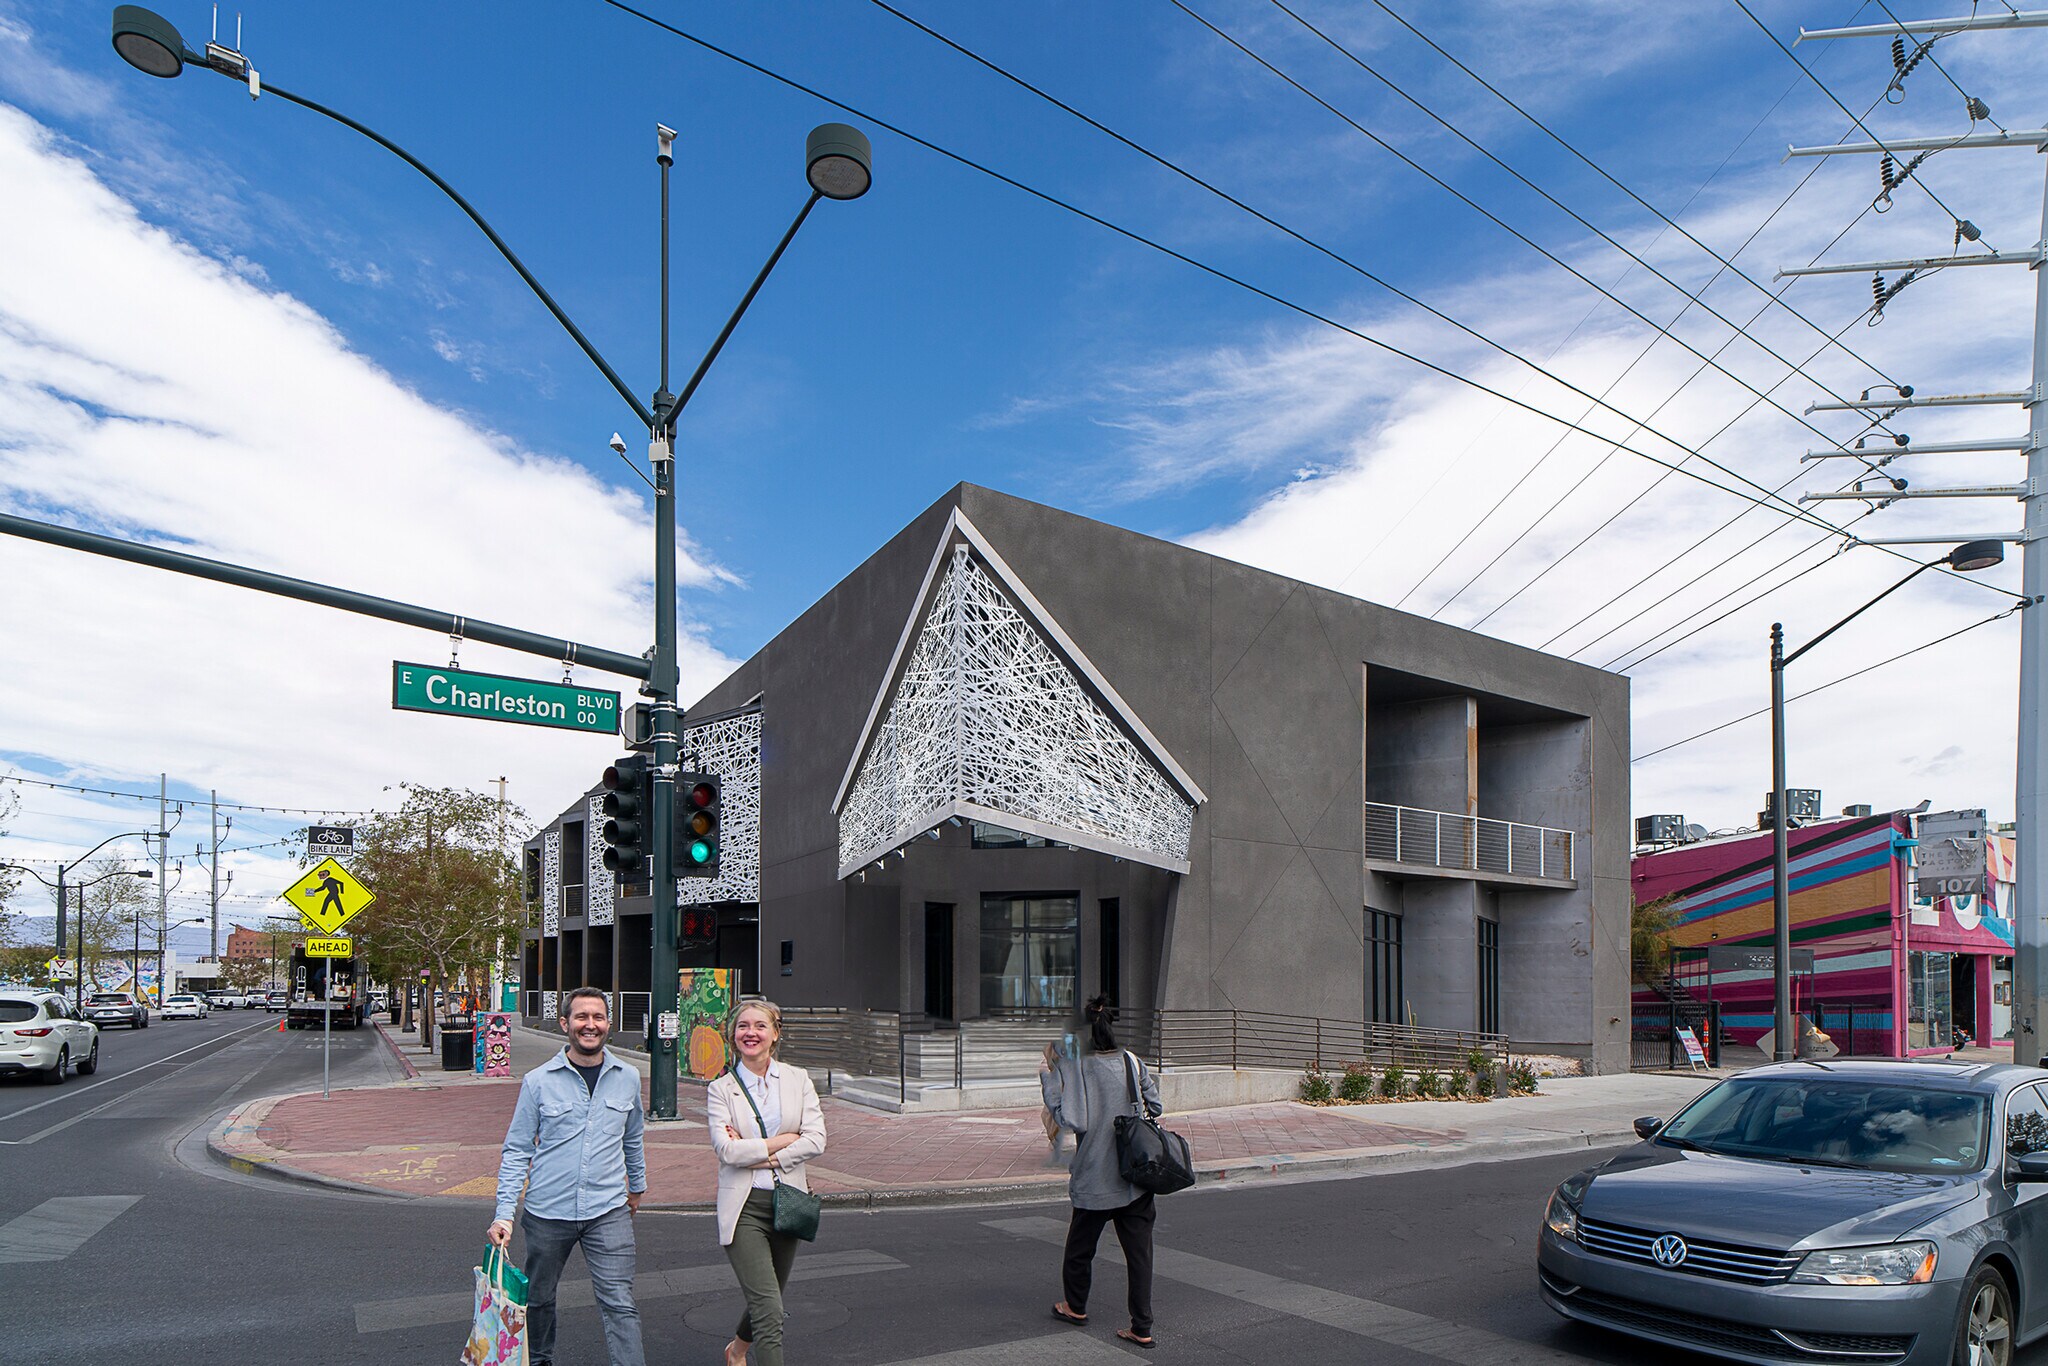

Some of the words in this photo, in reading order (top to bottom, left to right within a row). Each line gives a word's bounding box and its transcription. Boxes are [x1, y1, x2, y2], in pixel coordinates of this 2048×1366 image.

[402, 671, 413, 685] E
[426, 674, 566, 719] Charleston
[577, 694, 613, 710] BLVD
[577, 712, 597, 725] 00
[310, 844, 328, 853] BIKE
[330, 845, 351, 854] LANE
[1922, 857, 1977, 866] FACTO
[1937, 878, 1977, 893] 107
[309, 942, 349, 952] AHEAD
